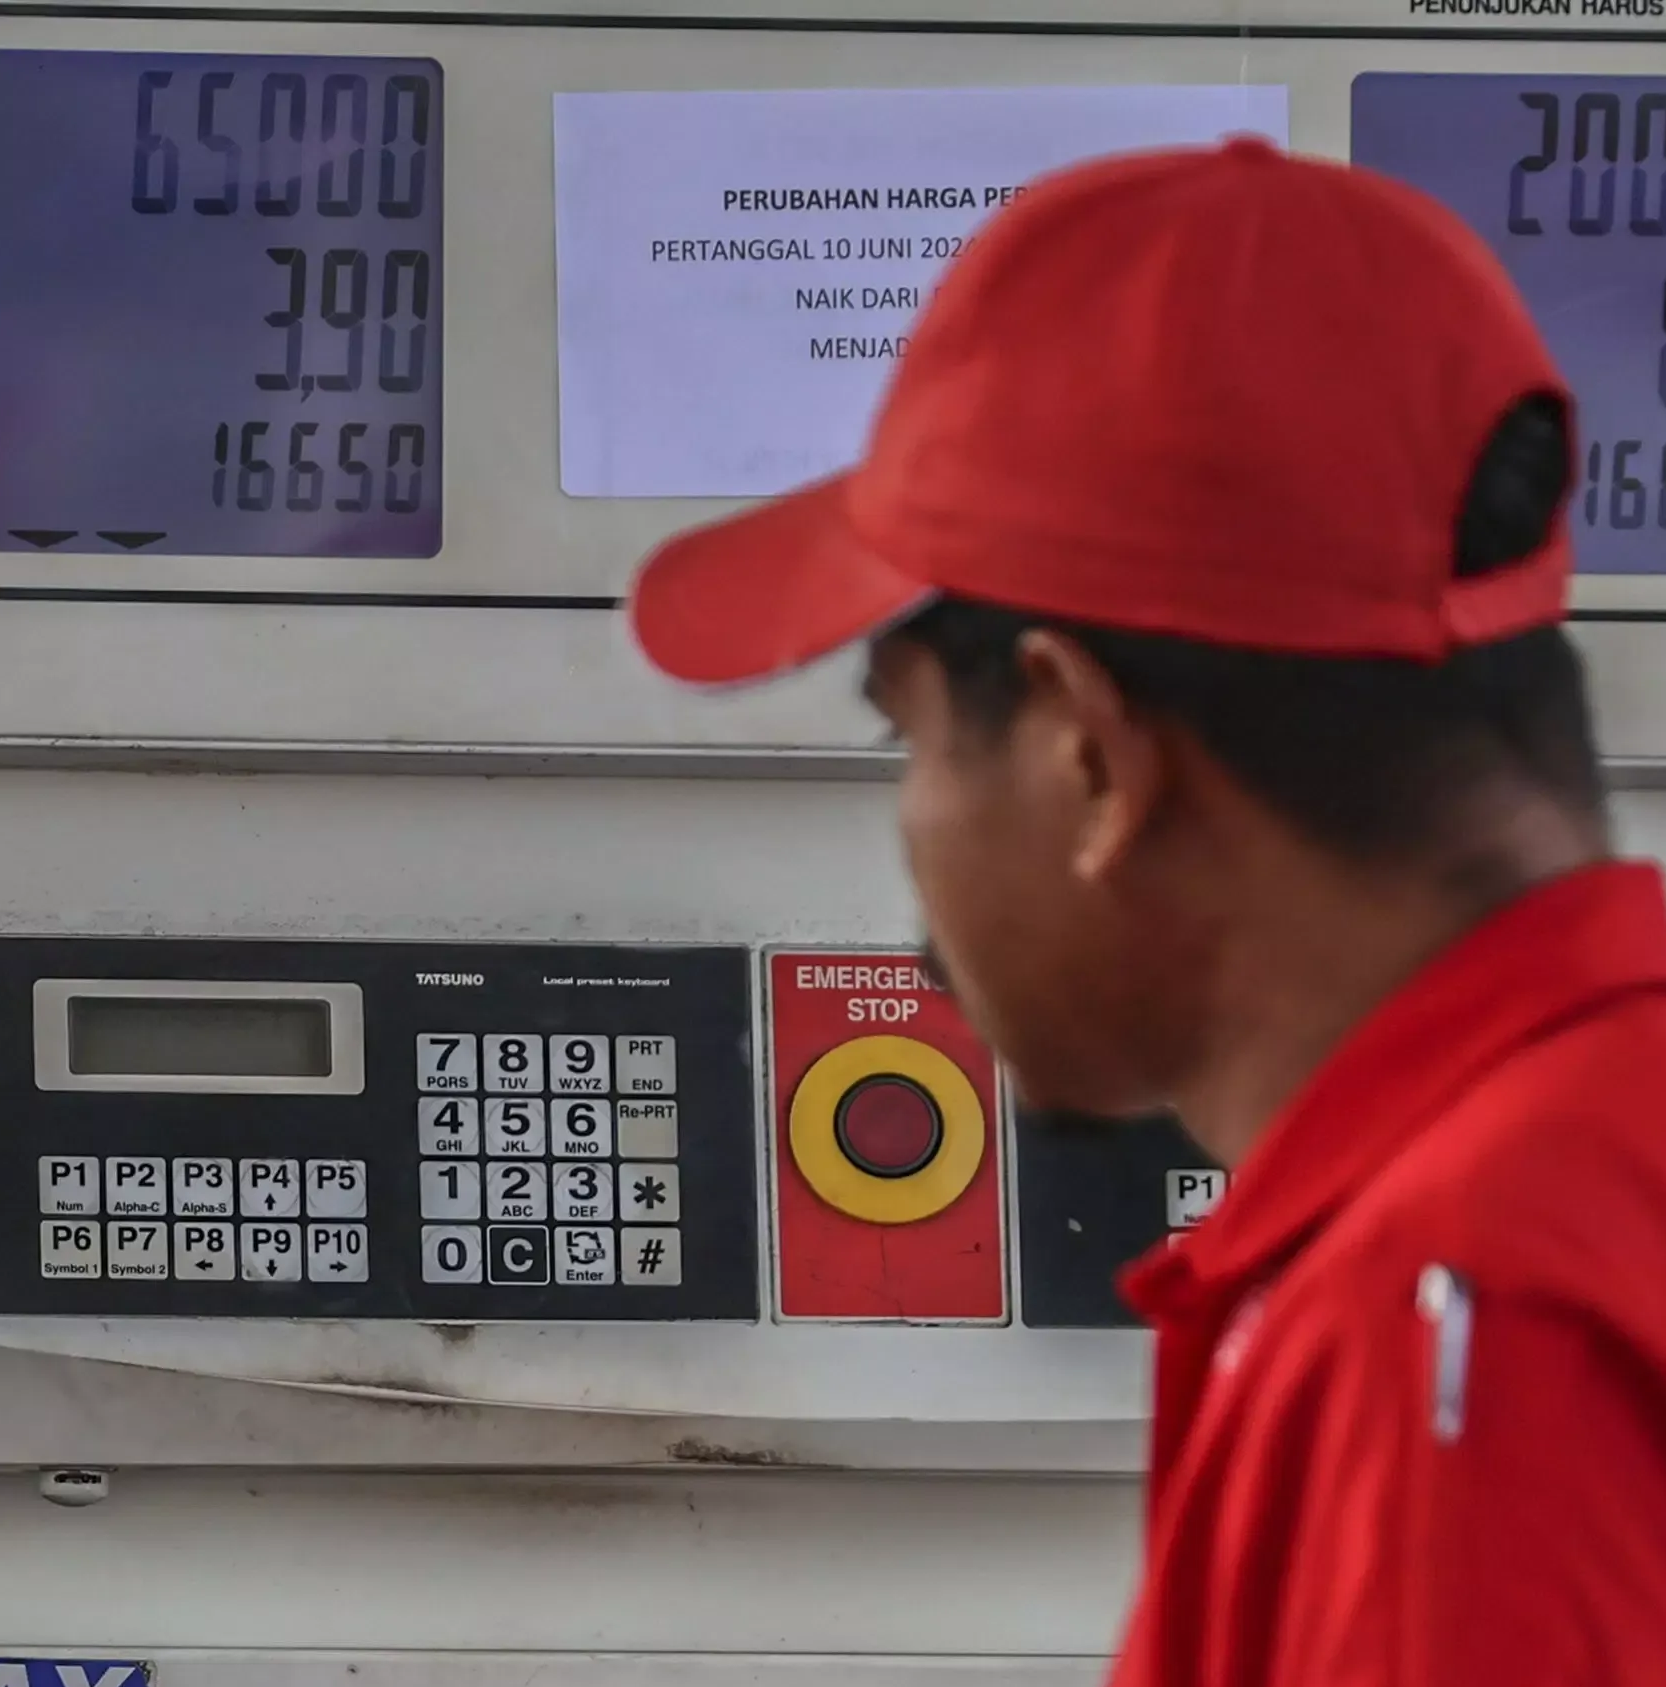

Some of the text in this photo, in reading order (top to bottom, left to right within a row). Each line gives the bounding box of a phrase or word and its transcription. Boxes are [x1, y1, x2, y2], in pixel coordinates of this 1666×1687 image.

[1410, 0, 1570, 14] PENUNJUKAN
[1582, 0, 1664, 15] HARUS
[133, 70, 431, 218] 65000
[724, 189, 878, 211] PERUBAHAN
[888, 187, 976, 209] HARGA
[652, 240, 814, 262] PERTANGGAL
[823, 238, 851, 260] 10
[858, 237, 912, 260] JUNI
[796, 288, 853, 309] NAIK
[862, 288, 918, 309] DARI
[255, 248, 430, 402] 3,90
[810, 337, 913, 359] MENJAD
[213, 422, 425, 513] 16650
[416, 974, 484, 985] TATSUNO
[797, 966, 946, 991] EMERGEN
[848, 998, 919, 1021] STOP
[430, 1038, 460, 1071] 7
[499, 1039, 528, 1072] 8
[565, 1040, 594, 1073] 9
[629, 1041, 662, 1055] PRT
[427, 1076, 468, 1088] PQRS
[499, 1077, 528, 1089] TUV
[559, 1079, 601, 1090] WXYZ
[633, 1079, 662, 1090] END
[434, 1102, 463, 1134] 4
[501, 1103, 530, 1135] 5
[567, 1103, 596, 1136] 6
[620, 1105, 674, 1118] Re-PRT
[436, 1140, 462, 1151] GHI
[502, 1141, 530, 1152] JKL
[565, 1142, 599, 1153] MNO
[52, 1162, 85, 1186] P1
[117, 1163, 155, 1187] P2
[184, 1163, 222, 1187] P3
[252, 1164, 290, 1188] P4
[317, 1165, 355, 1190] P5
[438, 1166, 457, 1199] 1
[502, 1167, 530, 1199] 2
[569, 1164, 597, 1200] 3
[1178, 1175, 1212, 1199] P1
[57, 1201, 83, 1211] Num
[114, 1201, 160, 1214] Alpha-C
[182, 1203, 226, 1214] Alpha-S
[502, 1205, 533, 1217] ABC
[569, 1206, 598, 1217] DEF
[53, 1226, 91, 1250] P6
[118, 1227, 156, 1250] P7
[186, 1228, 224, 1252] P8
[253, 1229, 291, 1253] P9
[315, 1229, 360, 1254] P10
[504, 1239, 533, 1272] C
[45, 1263, 88, 1275] Symbol
[111, 1264, 155, 1276] Symbol
[566, 1269, 603, 1281] Enter
